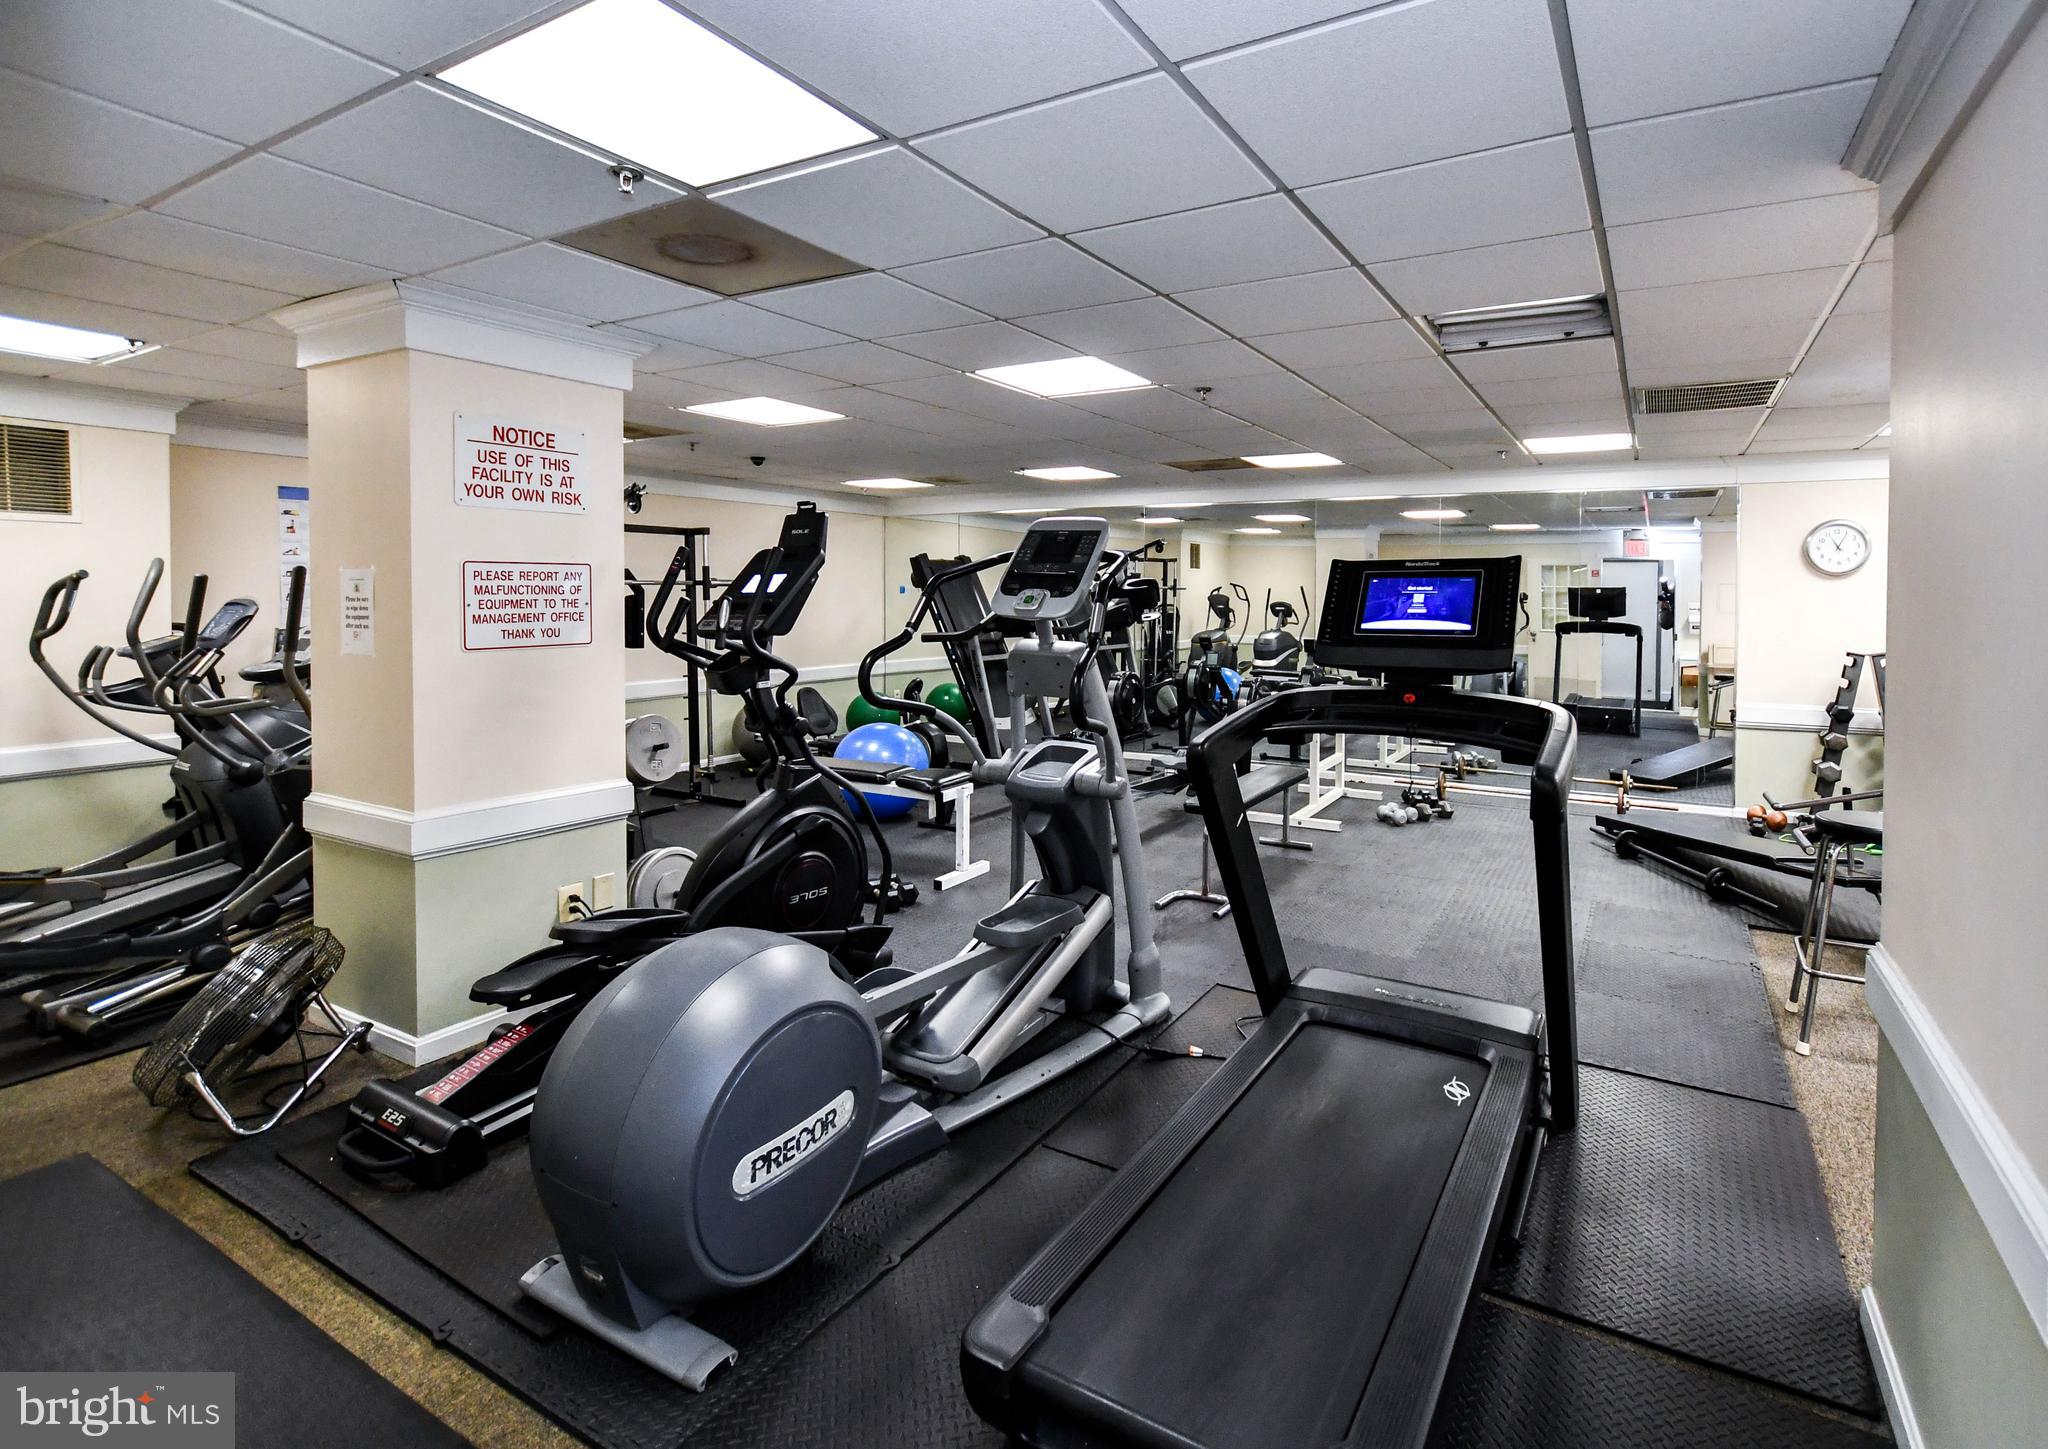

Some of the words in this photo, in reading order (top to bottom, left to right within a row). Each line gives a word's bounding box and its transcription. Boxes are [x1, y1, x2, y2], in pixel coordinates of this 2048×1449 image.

[493, 425, 556, 449] NOTICE
[477, 449, 507, 465] USE
[514, 453, 534, 468] OF
[540, 456, 570, 472] THIS
[472, 466, 533, 485] FACILITY
[540, 473, 553, 487] IS
[559, 476, 575, 489] AT
[464, 482, 504, 499] YOUR
[511, 487, 545, 503] OWN
[551, 491, 582, 506] RISK
[473, 570, 514, 581] PLEASE
[519, 571, 560, 581] REPORT
[563, 572, 583, 581] ANY
[474, 585, 565, 595] MALFUNCTIONING
[569, 585, 582, 595] OF
[478, 599, 539, 610] EQUIPMENT
[543, 598, 556, 609] TO
[561, 598, 579, 608] THE
[472, 613, 546, 624] MANAGEMENT
[550, 611, 585, 622] OFFICE
[501, 629, 535, 639] THANK
[540, 628, 561, 638] YOU
[789, 886, 828, 904] SOLE
[381, 1108, 406, 1127] E25
[750, 1108, 837, 1184] PRECOR
